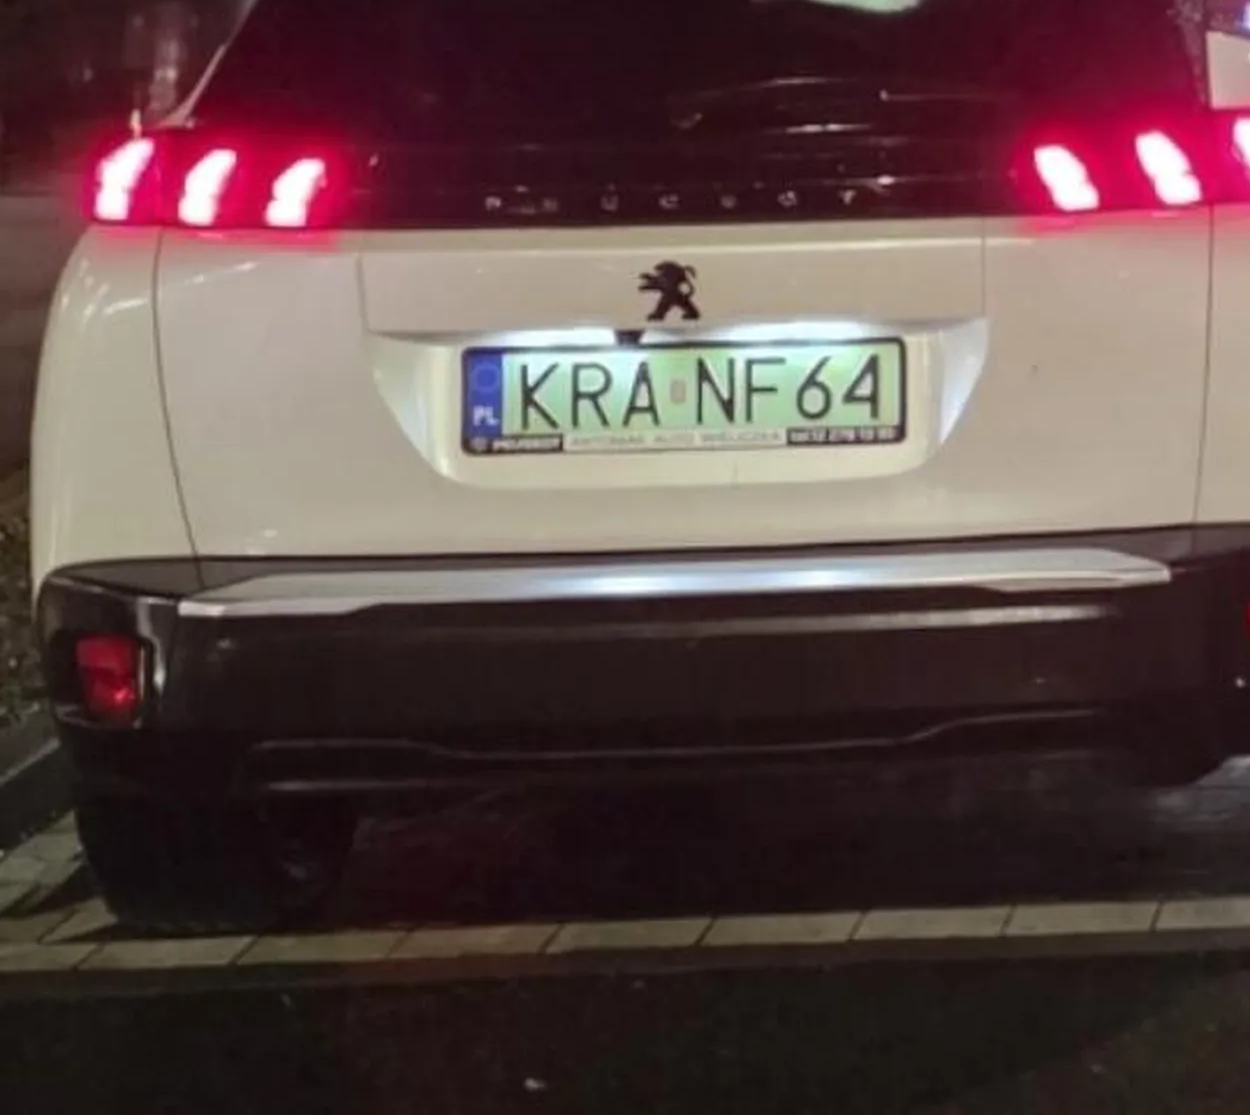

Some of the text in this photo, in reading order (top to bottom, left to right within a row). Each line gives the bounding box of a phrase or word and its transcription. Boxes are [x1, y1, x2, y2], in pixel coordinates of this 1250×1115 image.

[473, 405, 499, 426] PL
[519, 353, 880, 430] KRA NF64
